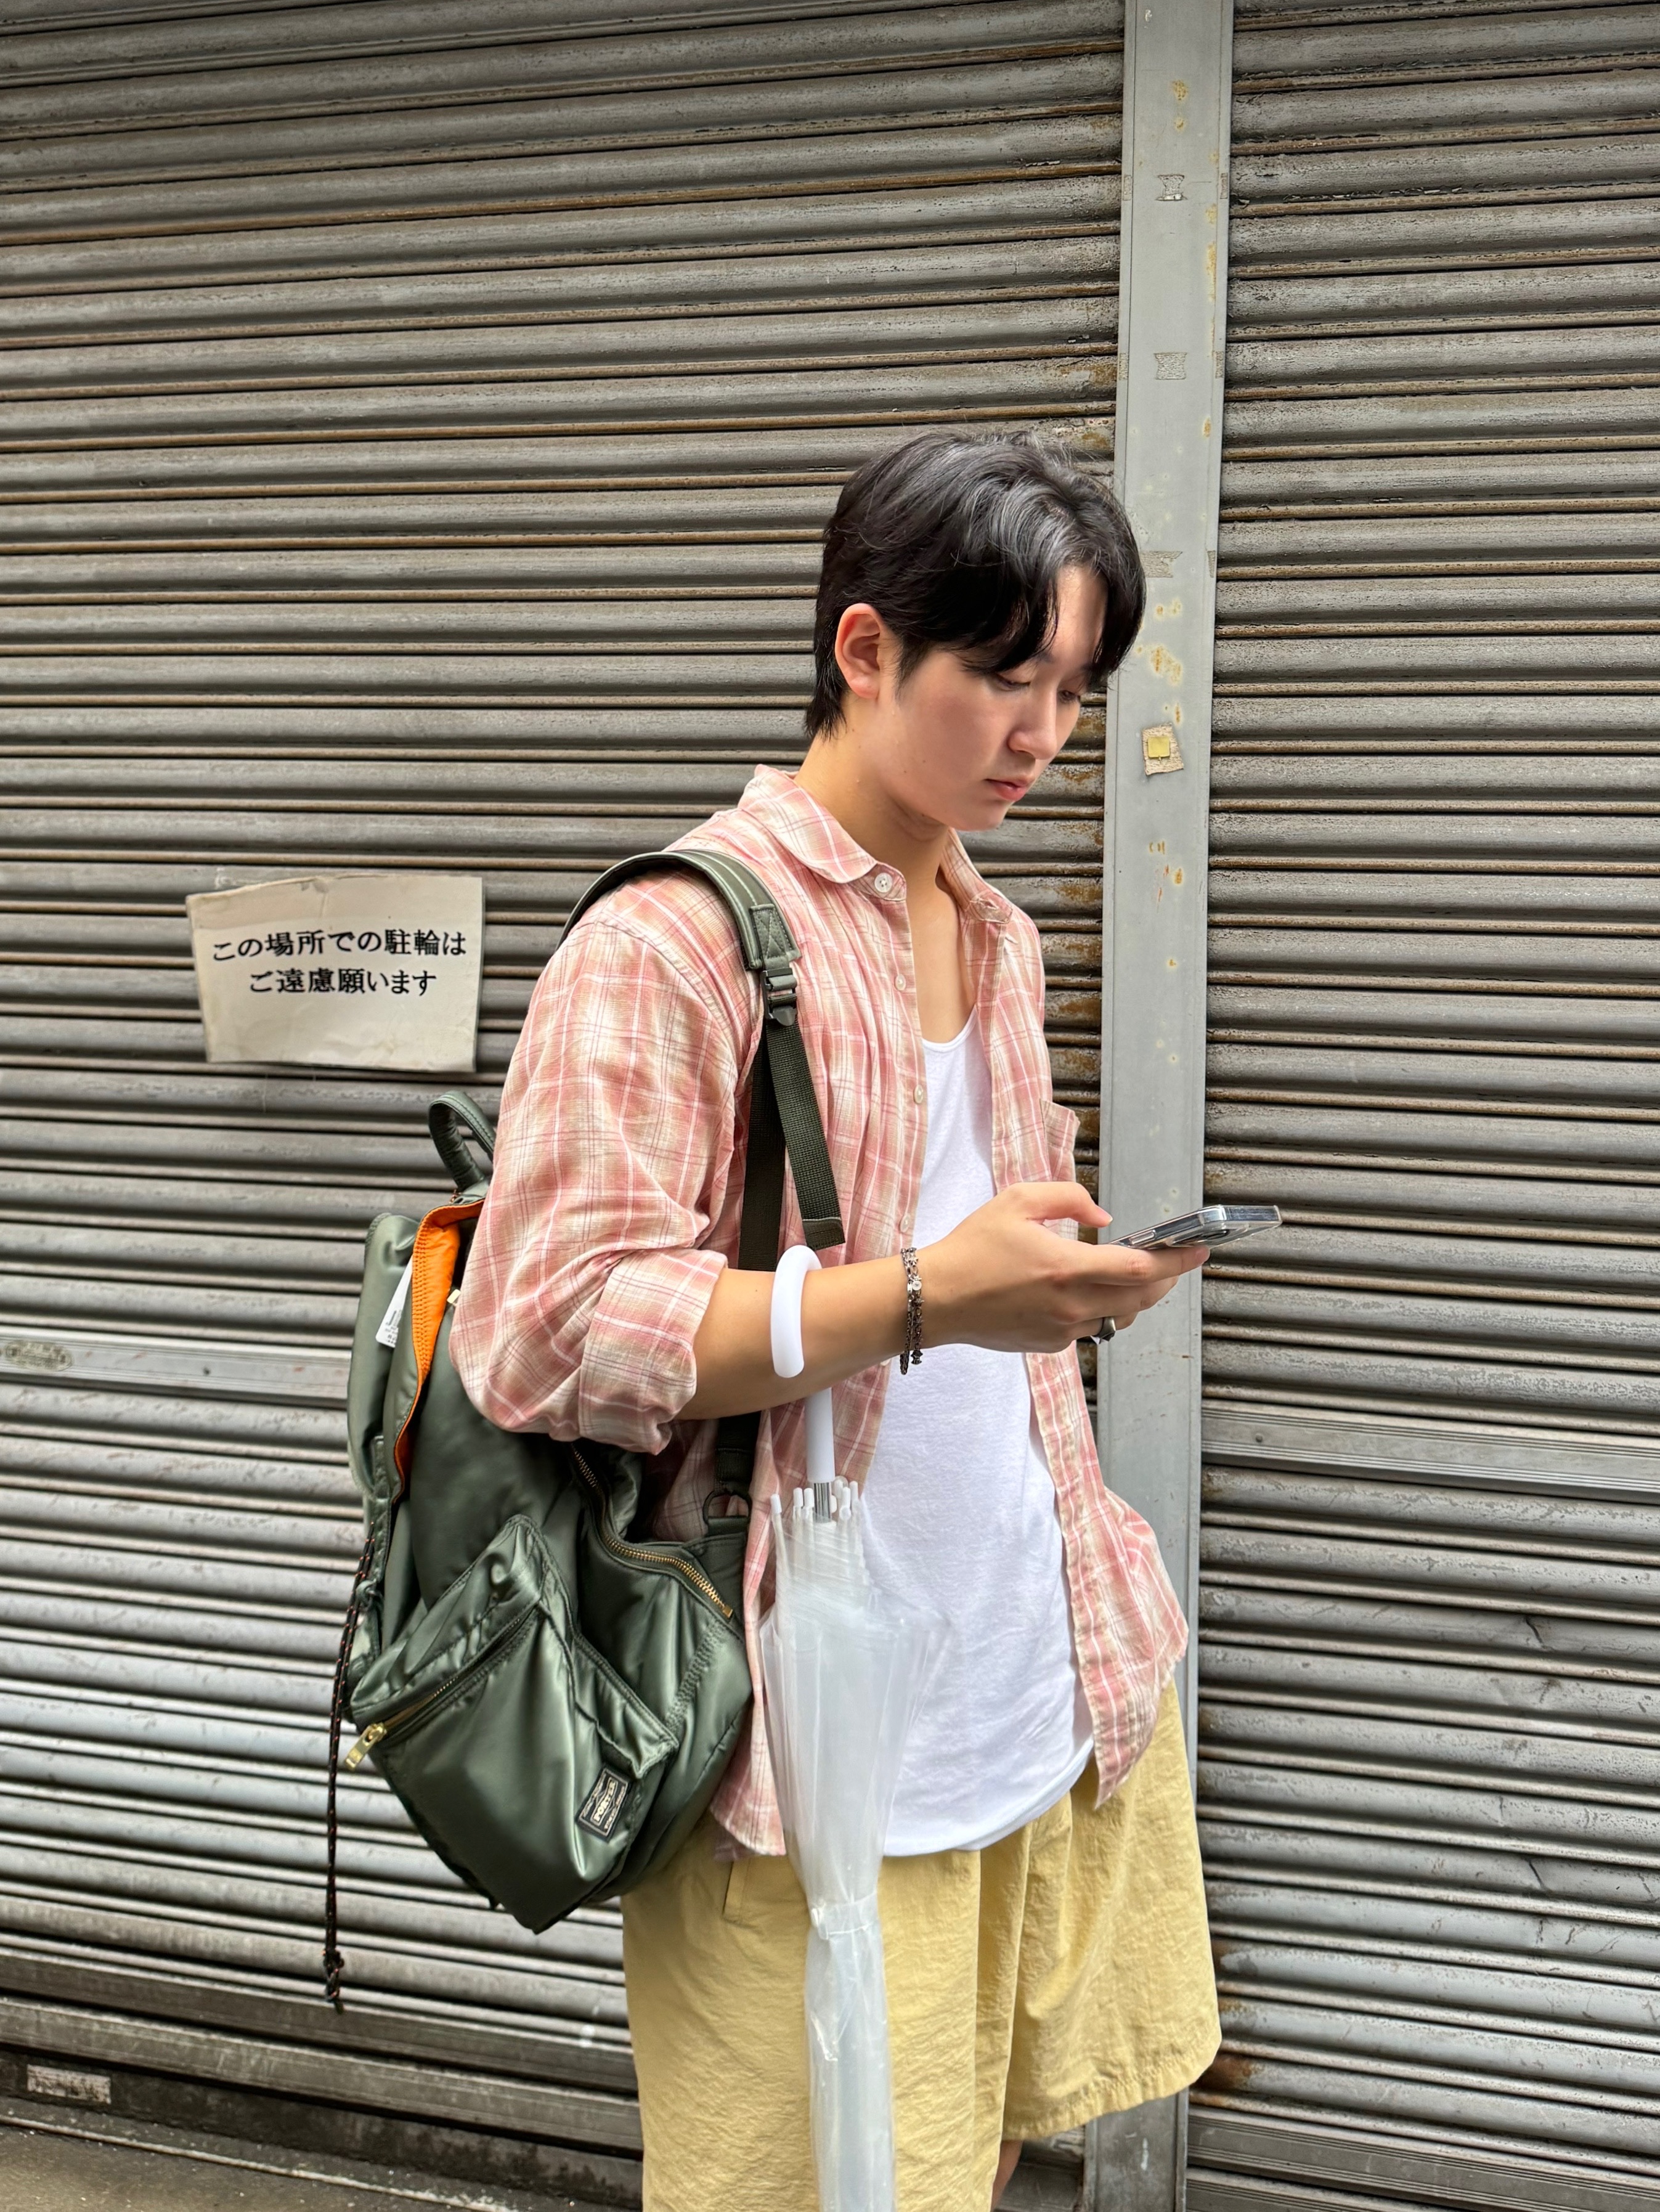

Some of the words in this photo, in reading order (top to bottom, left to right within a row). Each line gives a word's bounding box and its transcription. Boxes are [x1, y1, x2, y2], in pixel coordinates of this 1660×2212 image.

[213, 929, 466, 961] この場所での駐輪は
[250, 968, 436, 996] ご遠慮願います
[593, 1779, 617, 1822] PORTER
